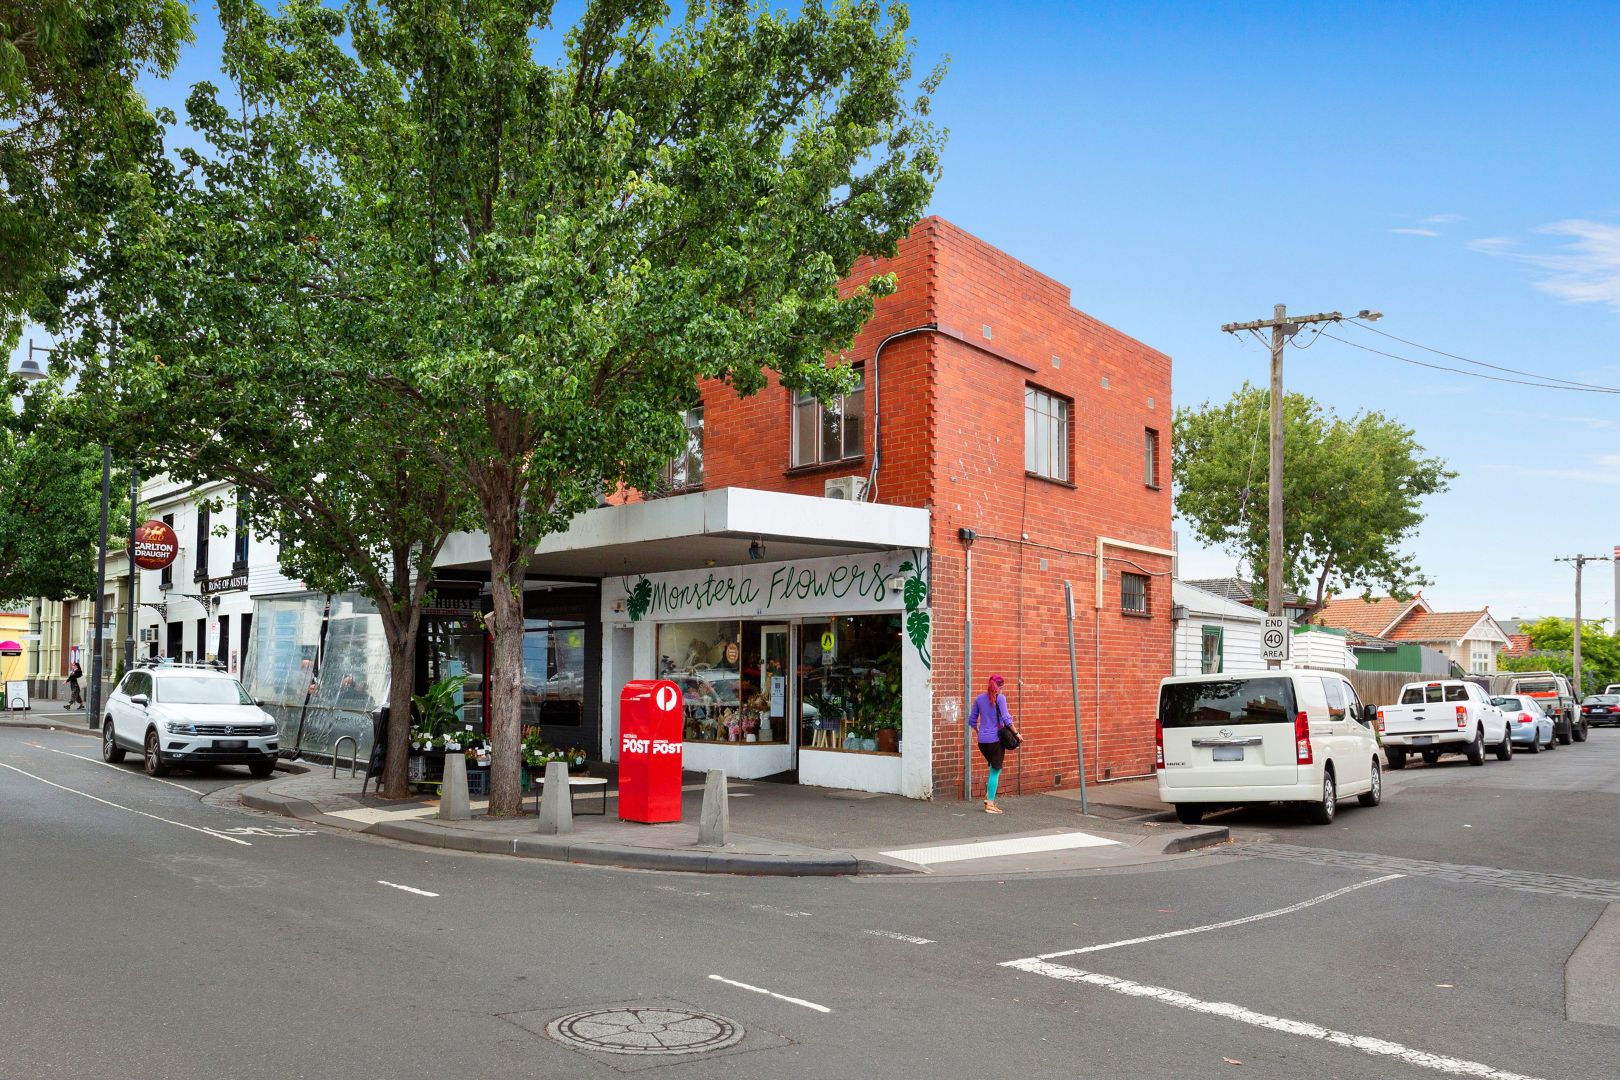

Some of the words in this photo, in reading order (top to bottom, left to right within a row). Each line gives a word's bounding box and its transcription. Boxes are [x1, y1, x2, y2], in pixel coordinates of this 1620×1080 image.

[135, 542, 173, 552] CARLTON
[135, 550, 170, 558] DRAUGHT
[208, 580, 222, 591] ROSE
[222, 579, 230, 589] OF
[650, 573, 760, 615] Monstera
[767, 562, 893, 609] Flowers
[1265, 619, 1283, 628] END
[1266, 634, 1282, 644] 40
[1263, 650, 1284, 658] AREA
[623, 738, 650, 754] POST
[652, 742, 682, 755] POST
